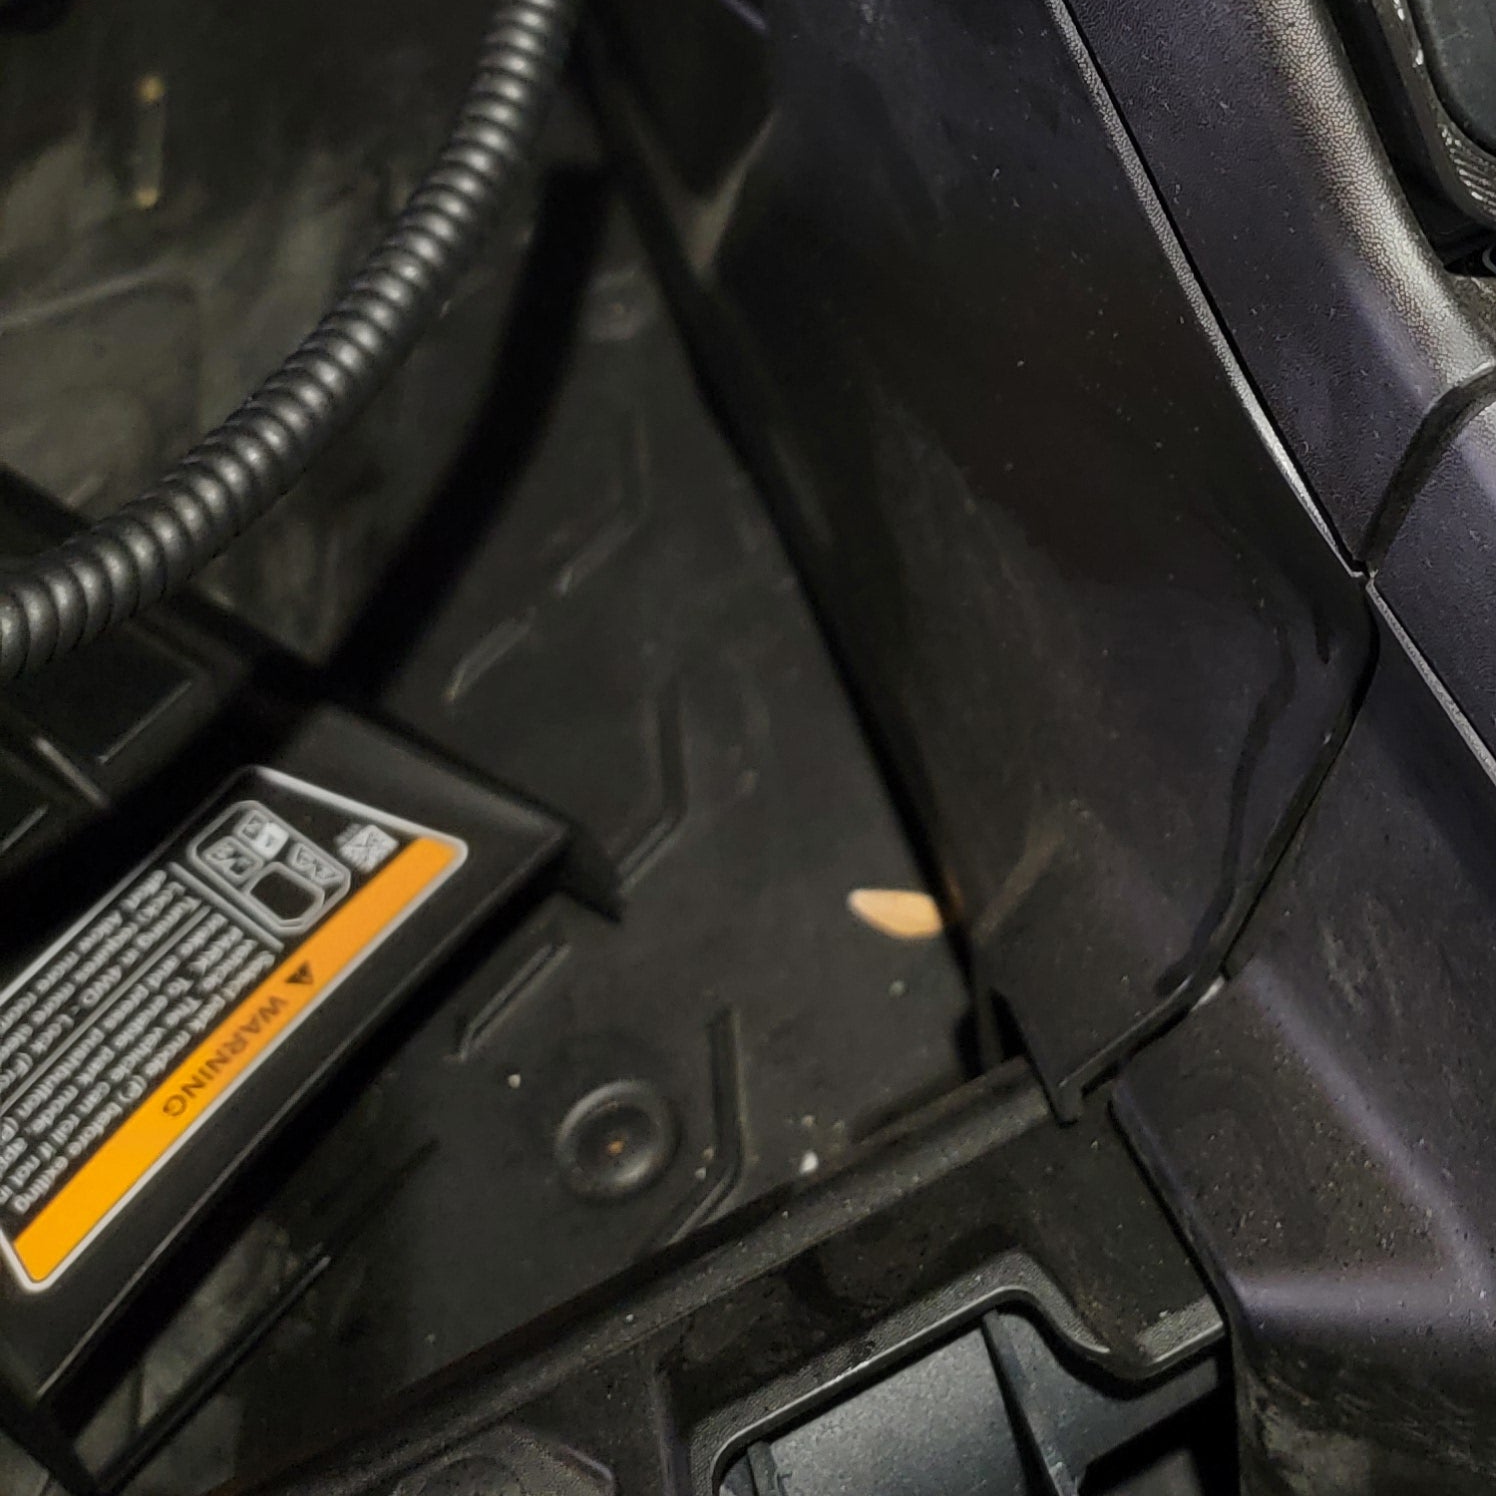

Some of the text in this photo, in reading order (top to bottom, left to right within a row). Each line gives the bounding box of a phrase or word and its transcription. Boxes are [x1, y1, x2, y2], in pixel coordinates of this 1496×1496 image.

[72, 919, 138, 985] requires
[76, 908, 124, 956] Allow
[34, 949, 78, 994] more
[77, 962, 123, 1009] 4WD
[145, 954, 181, 991] and
[163, 972, 192, 1001] To
[30, 981, 75, 1026] more
[100, 982, 148, 1031] press
[110, 992, 169, 1051] enable
[163, 992, 201, 1030] The
[185, 993, 225, 1033] park
[29, 1012, 73, 1055] Lock
[108, 1023, 167, 1083] vehicle
[142, 1029, 191, 1078] mode
[13, 1026, 105, 1118] pushbutton
[73, 1044, 115, 1086] park
[158, 992, 288, 1121] WARNING
[77, 1081, 110, 1114] can
[36, 1141, 54, 1159] if
[51, 1114, 81, 1144] roll
[66, 1101, 122, 1157] before
[8, 1154, 41, 1187] not
[10, 1154, 70, 1214] exiting
